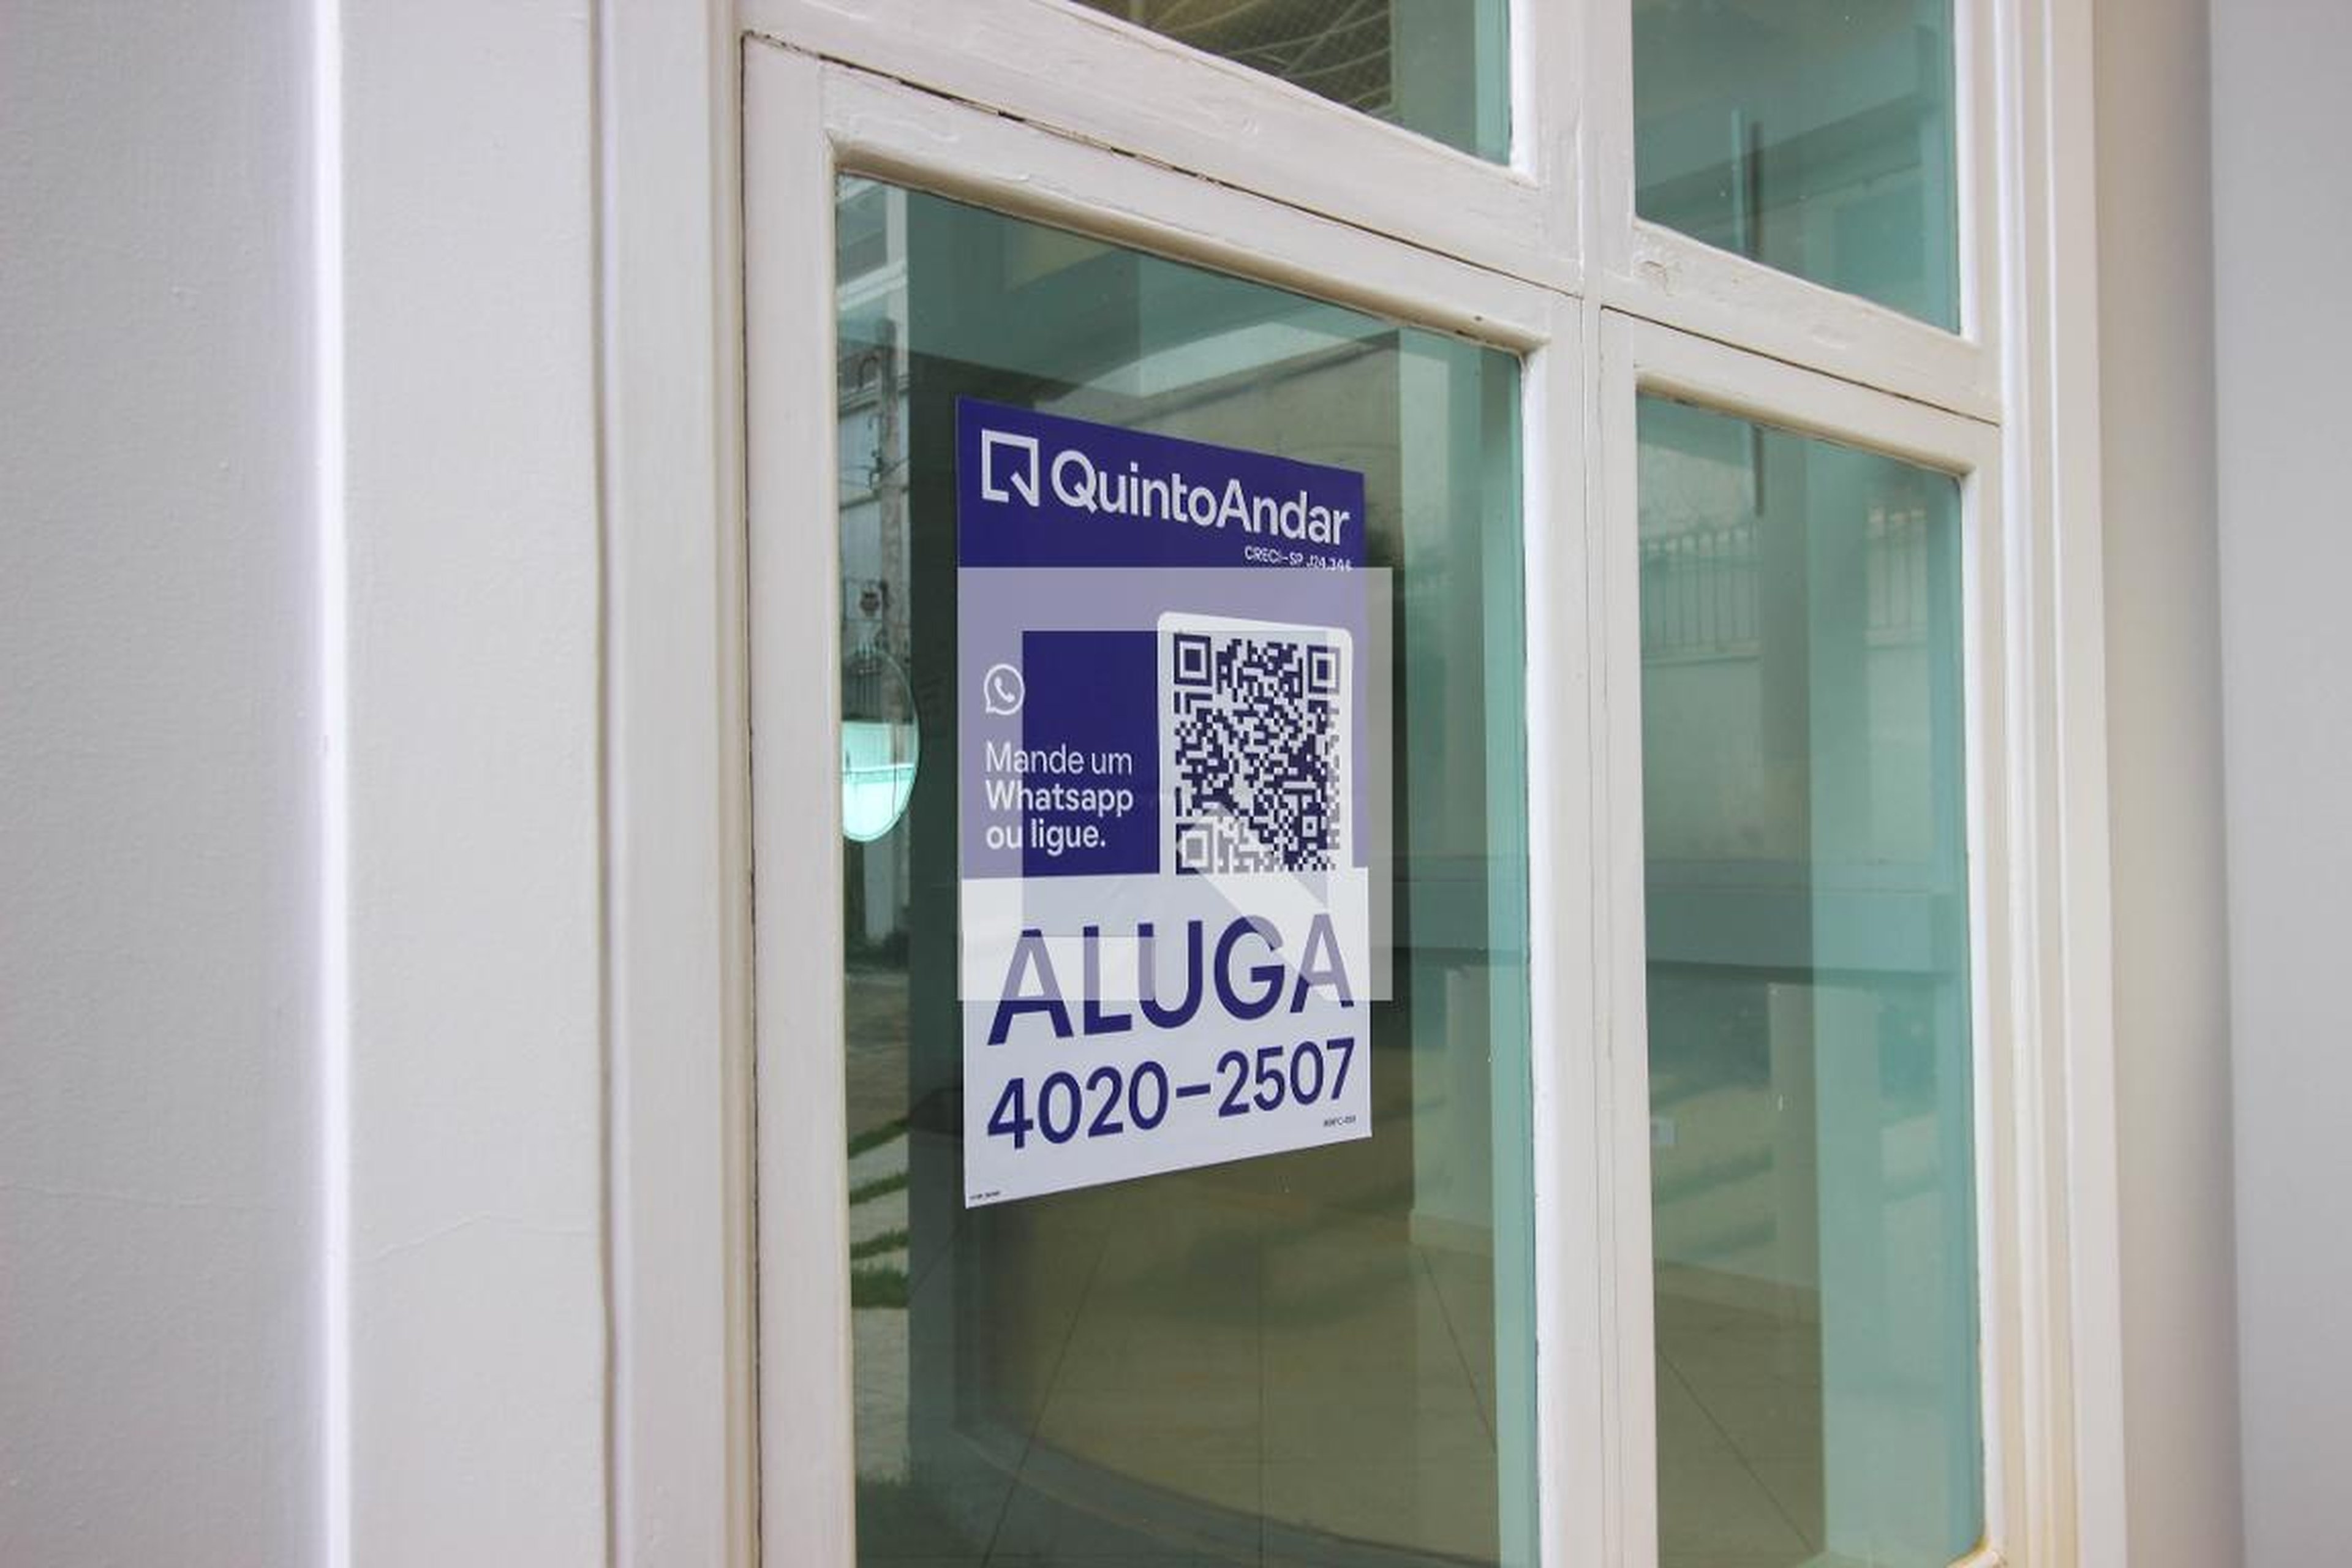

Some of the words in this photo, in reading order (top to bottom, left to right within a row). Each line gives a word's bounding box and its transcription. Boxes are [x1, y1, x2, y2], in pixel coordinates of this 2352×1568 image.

[1051, 450, 1350, 545] QuintoAndar
[1245, 545, 1303, 565] CRECI-SP
[985, 741, 1085, 775] Mande
[1091, 750, 1133, 775] um
[986, 778, 1134, 816] Whatsapp
[986, 824, 1023, 850] ou
[1030, 818, 1106, 856] ligue.
[987, 913, 1355, 1046] ALUGA
[987, 1036, 1355, 1150] 4020-2507
